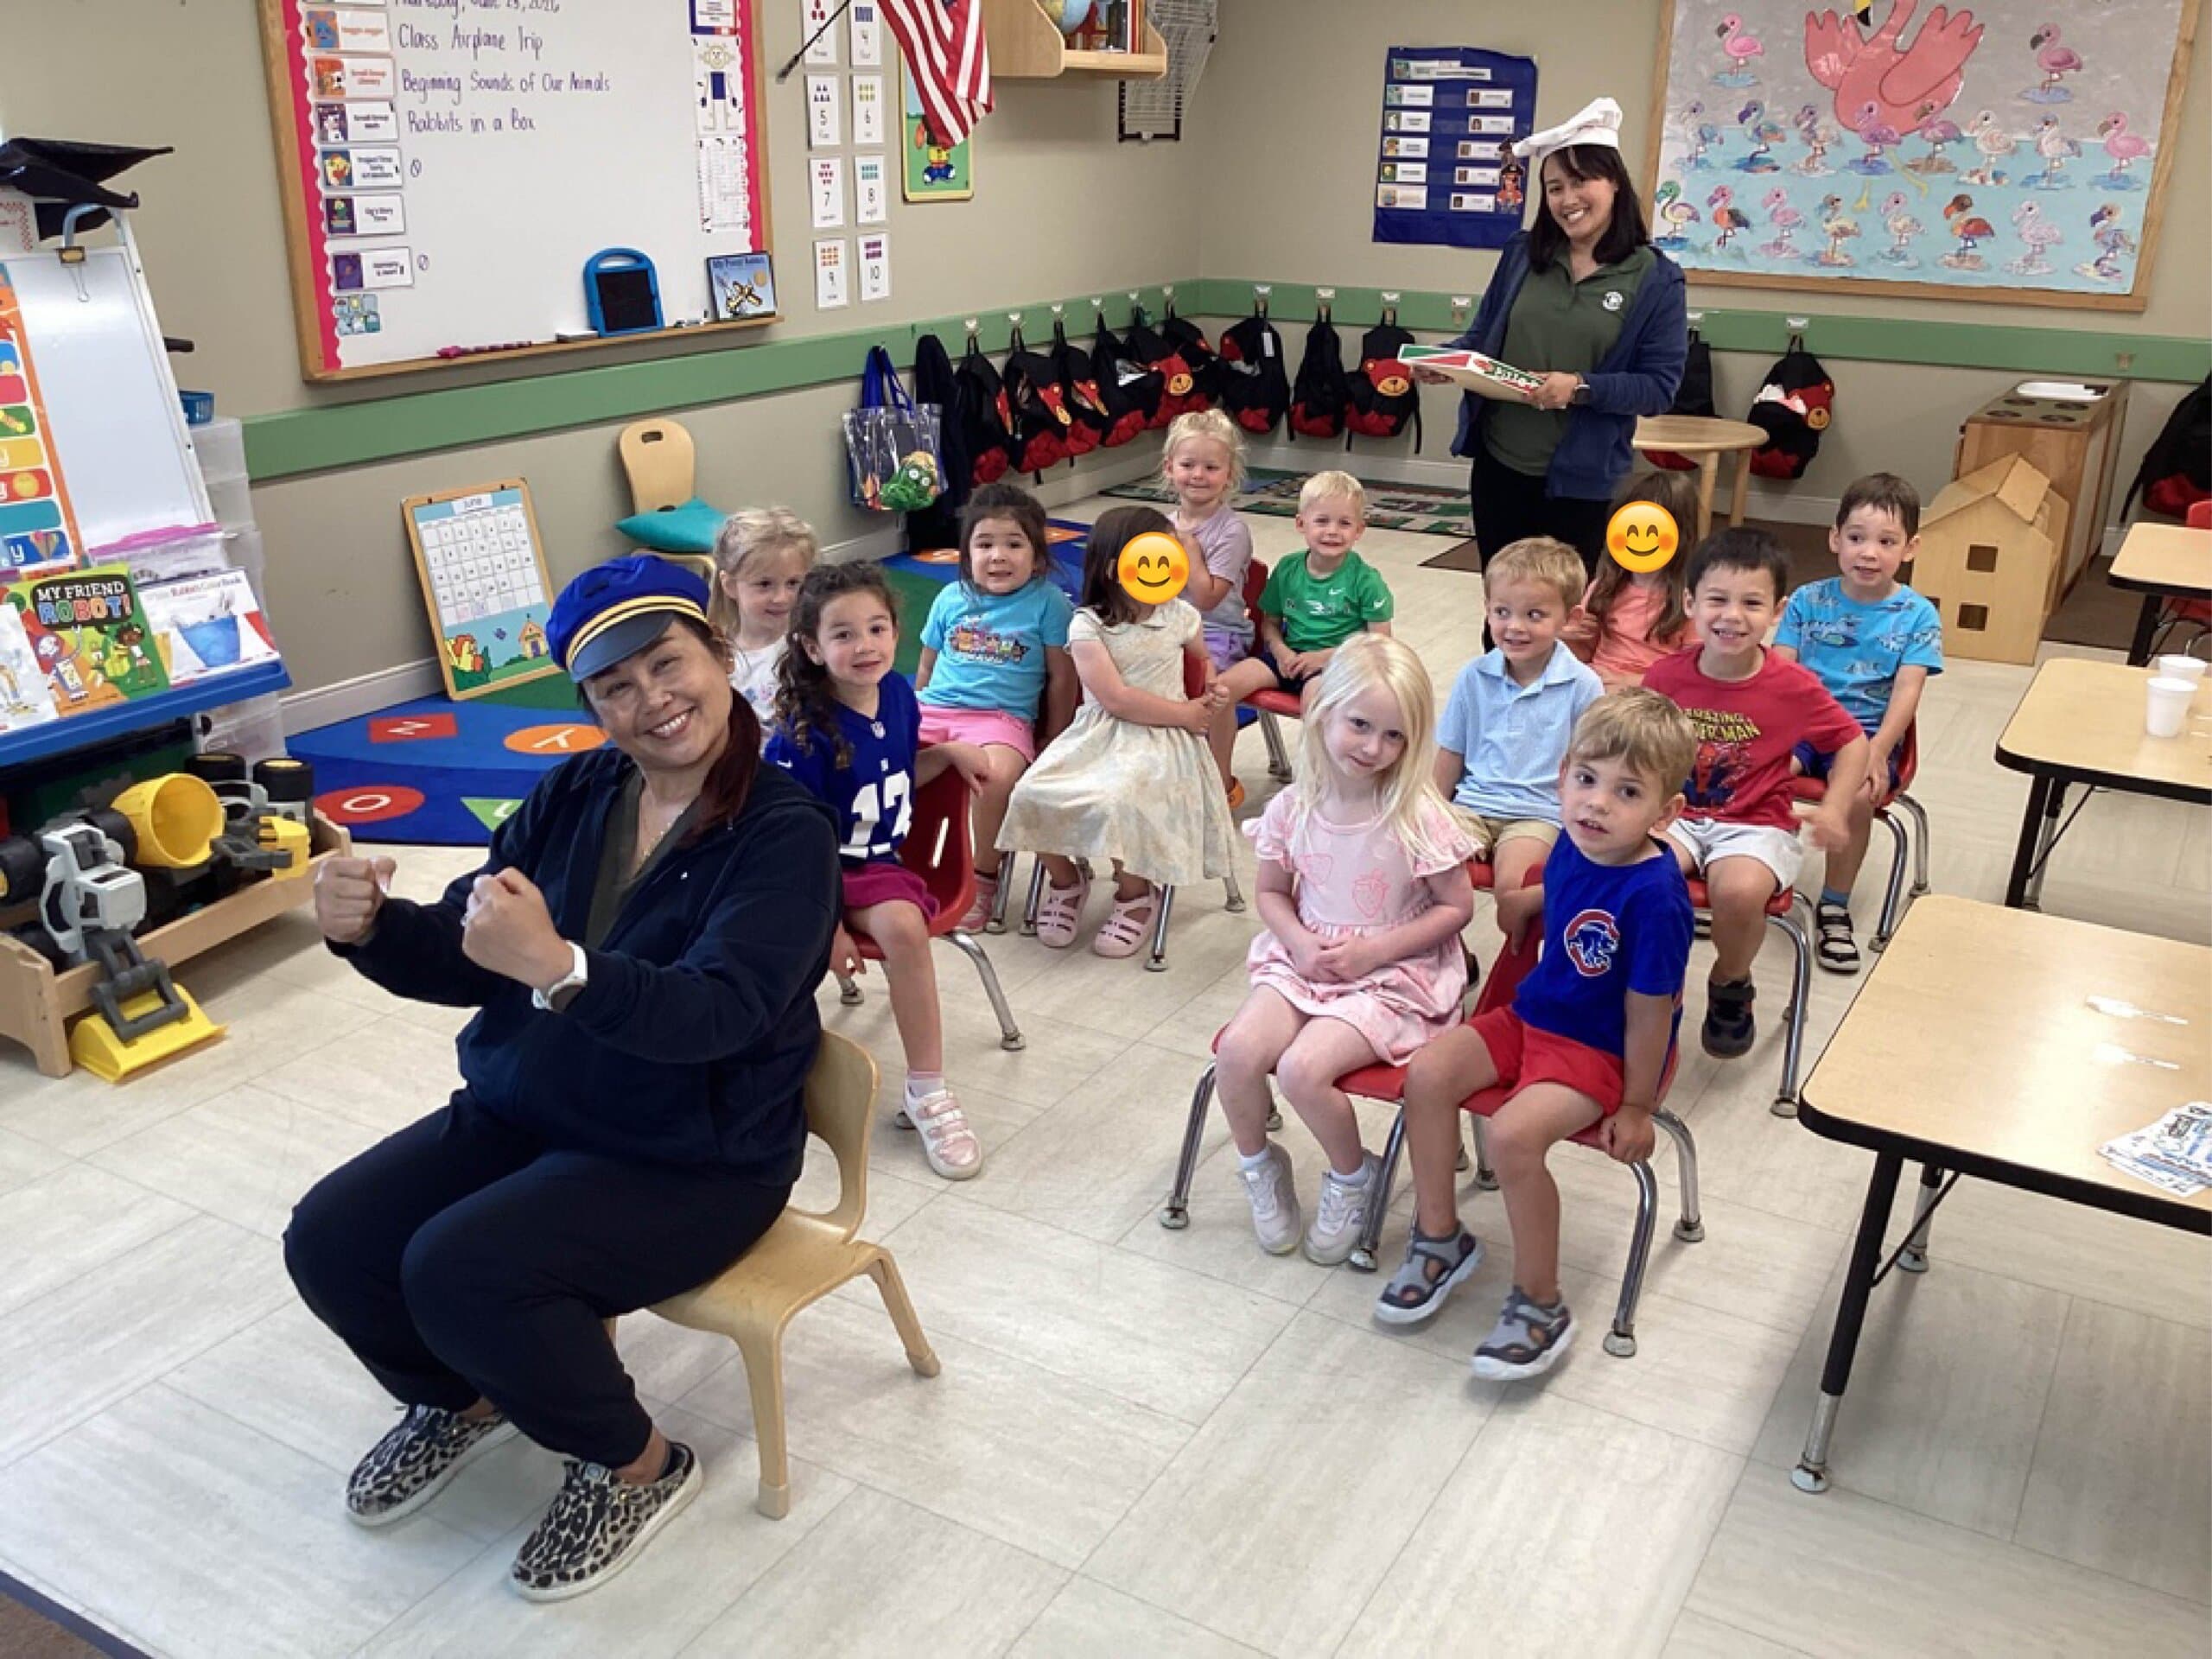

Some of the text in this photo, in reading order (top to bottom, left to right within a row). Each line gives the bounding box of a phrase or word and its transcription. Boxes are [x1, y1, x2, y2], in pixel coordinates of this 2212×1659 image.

[399, 23, 543, 60] Class Airplane Trip
[402, 68, 461, 105] Beginning
[470, 69, 514, 91] Sounds
[520, 73, 536, 92] of
[542, 73, 563, 92] Our
[569, 71, 610, 92] Animals
[408, 107, 536, 133] Rabbits in a Box
[820, 110, 828, 126] 5
[823, 190, 830, 207] 7
[868, 188, 876, 204] 8
[870, 264, 880, 280] 10
[36, 581, 124, 601] MY FRIEND
[38, 594, 132, 624] ROBOT!
[341, 793, 391, 813] O
[838, 768, 912, 859] 17
